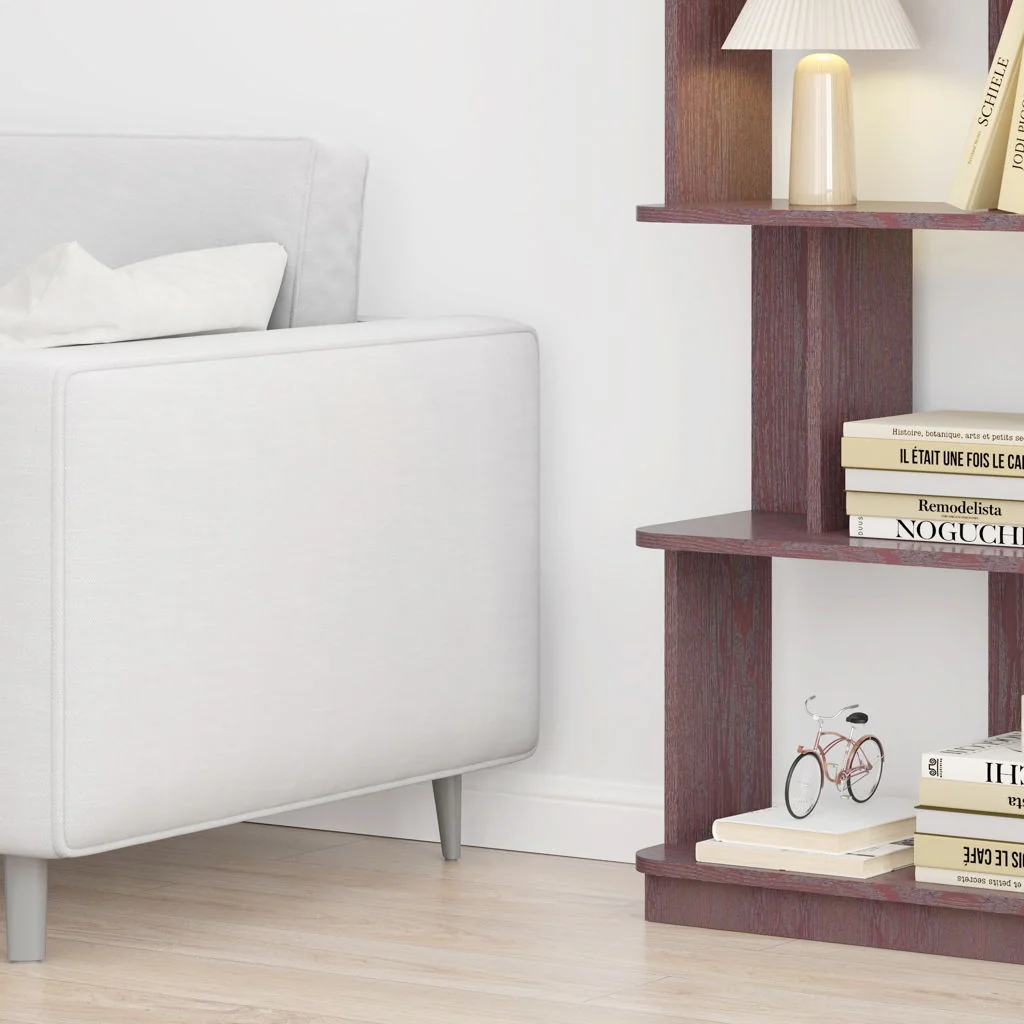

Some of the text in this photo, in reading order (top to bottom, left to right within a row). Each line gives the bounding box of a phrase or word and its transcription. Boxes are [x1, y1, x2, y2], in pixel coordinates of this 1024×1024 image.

[977, 56, 1010, 127] SCHIELE
[892, 428, 924, 438] Histoire,
[992, 433, 1014, 442] petits
[900, 448, 909, 464] IL
[912, 446, 941, 466] ÉTAIT
[943, 450, 964, 467] UNE
[966, 451, 990, 468] FOIS
[992, 453, 1005, 469] LE
[918, 498, 1002, 516] Remodelista
[963, 846, 992, 866] CAFÉ
[995, 849, 1008, 867] LE
[956, 875, 987, 885] secrets
[988, 878, 1012, 888] petits
